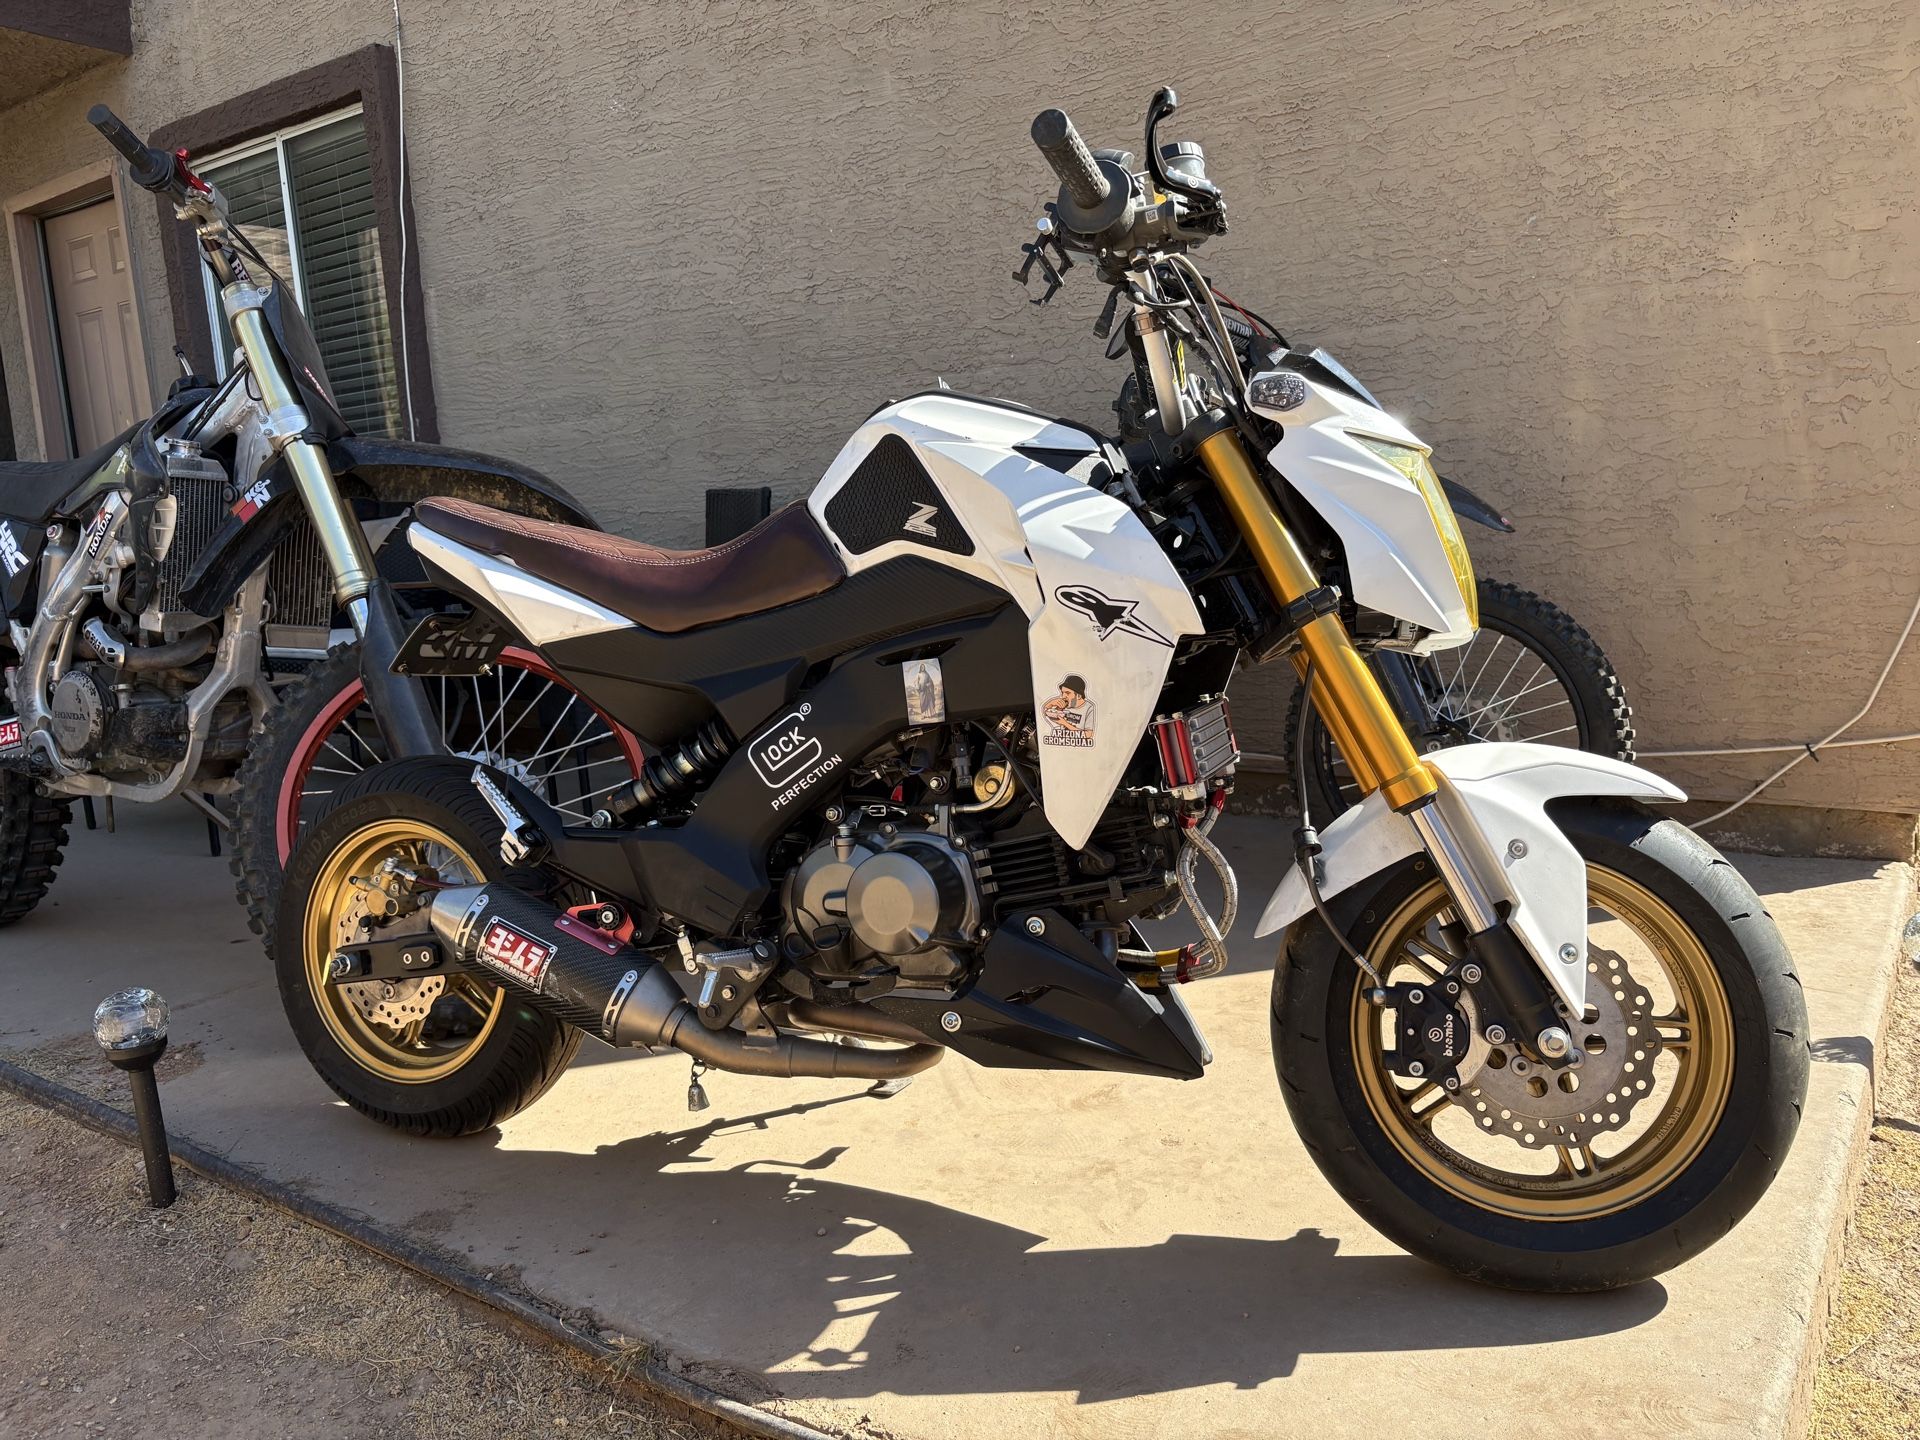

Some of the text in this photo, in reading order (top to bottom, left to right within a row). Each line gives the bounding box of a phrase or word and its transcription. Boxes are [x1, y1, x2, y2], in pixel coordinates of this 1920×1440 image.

[89, 513, 112, 557] HONDA
[0, 723, 18, 744] シムラ
[53, 711, 87, 721] HONDA
[1052, 729, 1086, 739] ARIZONA
[1043, 737, 1093, 747] GROMSQUAD
[771, 753, 843, 811] PERFECTION
[290, 829, 332, 889] KENDA
[484, 927, 544, 973] ヨシムラ
[1443, 1014, 1454, 1057] brembo
